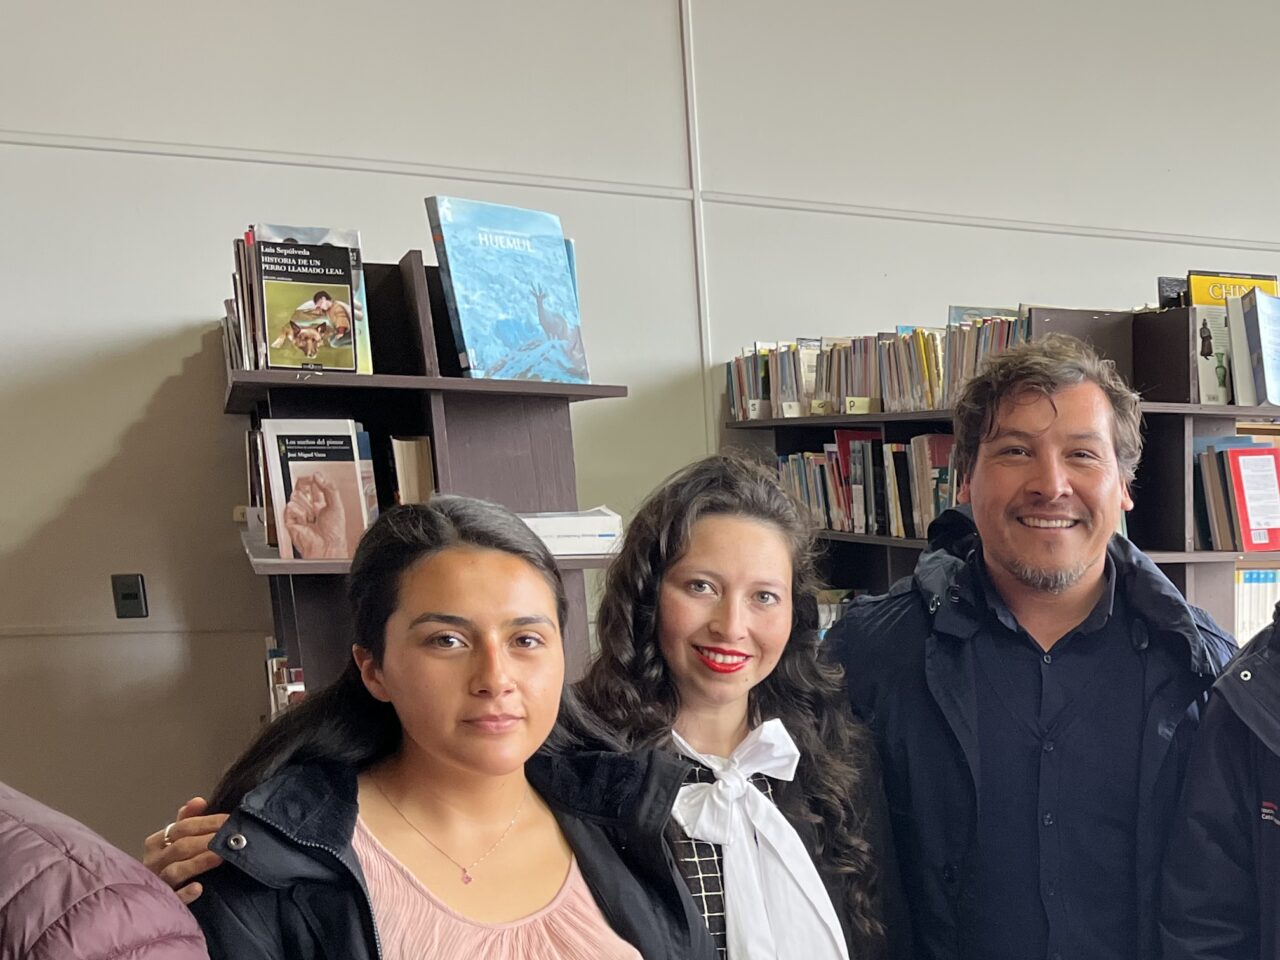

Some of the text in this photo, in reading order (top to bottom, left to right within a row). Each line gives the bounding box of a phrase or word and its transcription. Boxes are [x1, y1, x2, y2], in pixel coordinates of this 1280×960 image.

[478, 232, 536, 253] HUEMUL
[261, 245, 310, 256] Luis Sepúlveda
[262, 256, 297, 265] HISTORIA
[298, 258, 307, 266] DE
[262, 263, 287, 272] PERRO
[288, 265, 324, 275] LLAMADO
[849, 400, 856, 411] P
